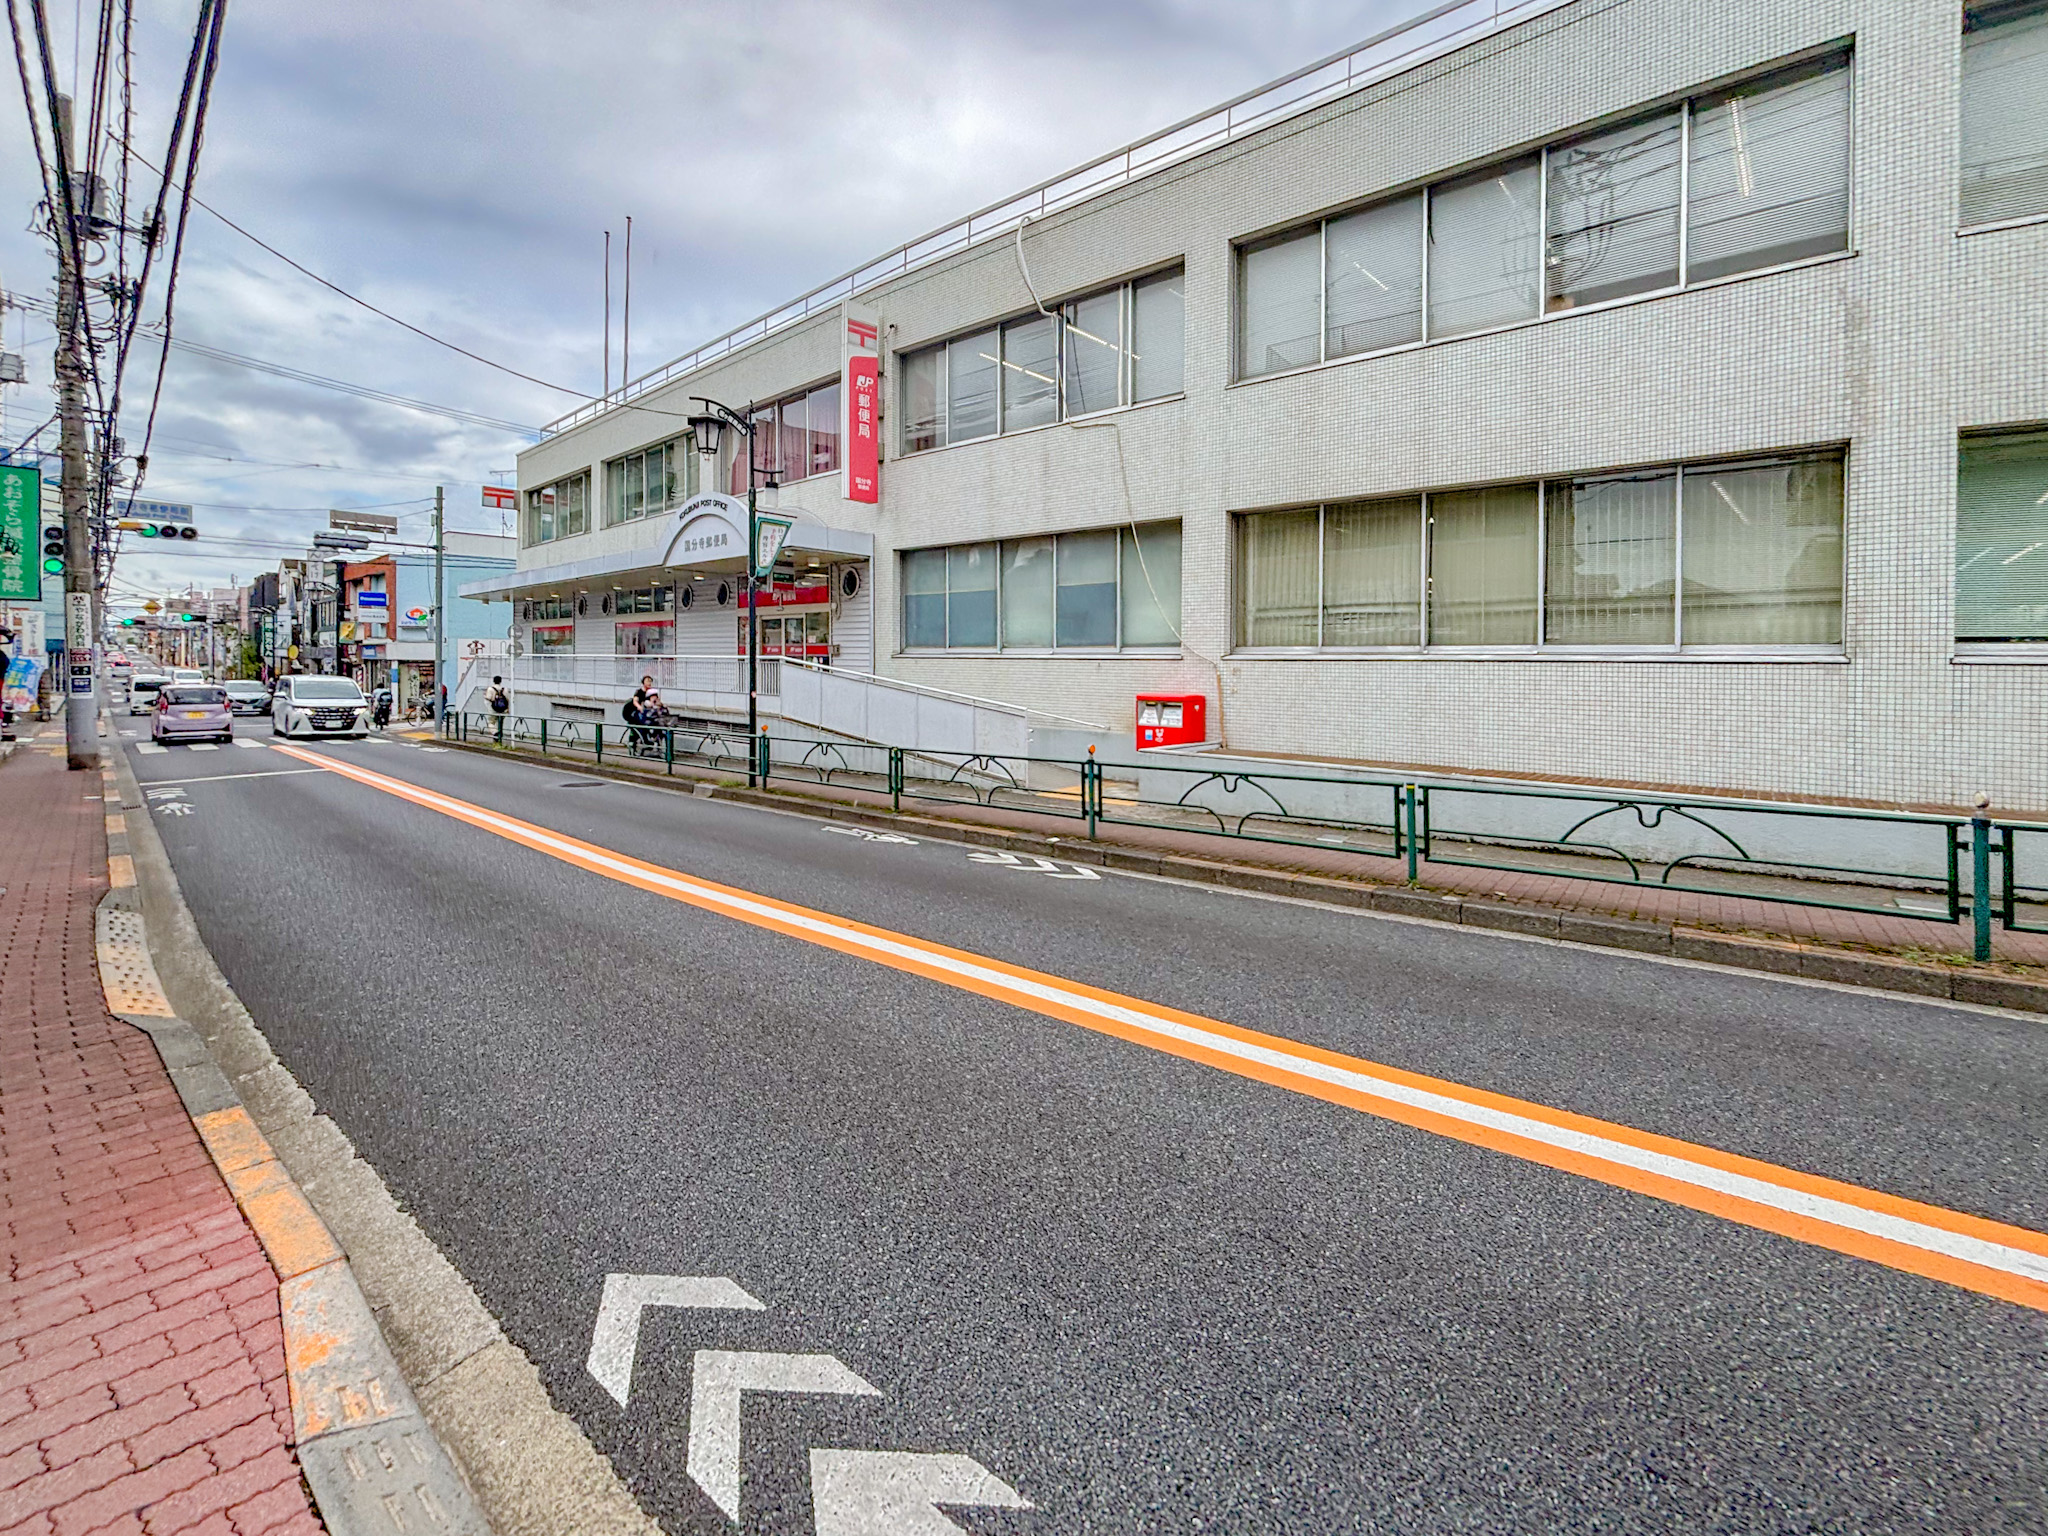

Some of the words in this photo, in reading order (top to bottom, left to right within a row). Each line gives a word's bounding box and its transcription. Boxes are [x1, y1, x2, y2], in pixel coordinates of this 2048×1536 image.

[858, 393, 870, 439] 郵便局
[700, 499, 712, 507] POST
[713, 500, 729, 512] OFFICE
[684, 533, 728, 552] 国分寺郵便局
